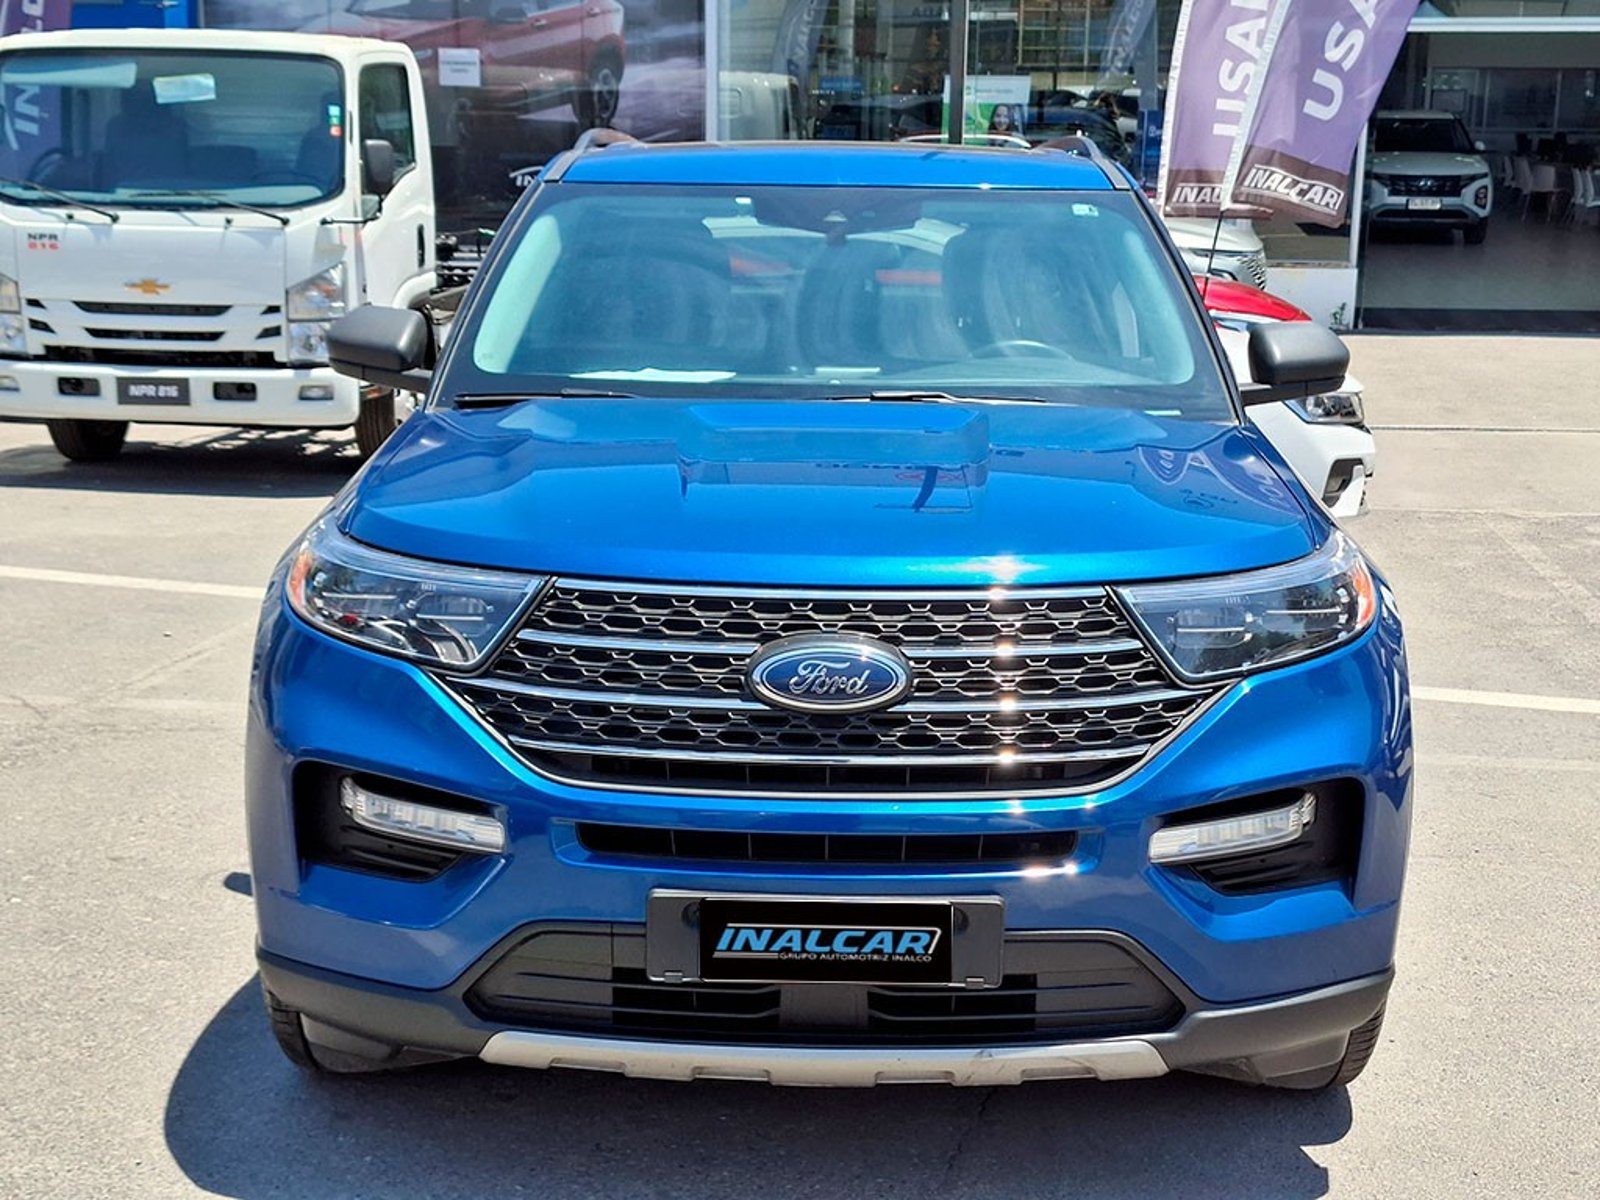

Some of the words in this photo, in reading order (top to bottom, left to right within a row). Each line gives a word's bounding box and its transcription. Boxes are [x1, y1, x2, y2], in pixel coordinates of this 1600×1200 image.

[1243, 169, 1338, 209] INALCAR
[129, 385, 156, 397] NPR
[789, 660, 870, 694] Ford
[716, 928, 930, 953] INALCAR
[779, 952, 817, 960] GRUPO
[820, 953, 889, 961] AUTOMOTRIZ
